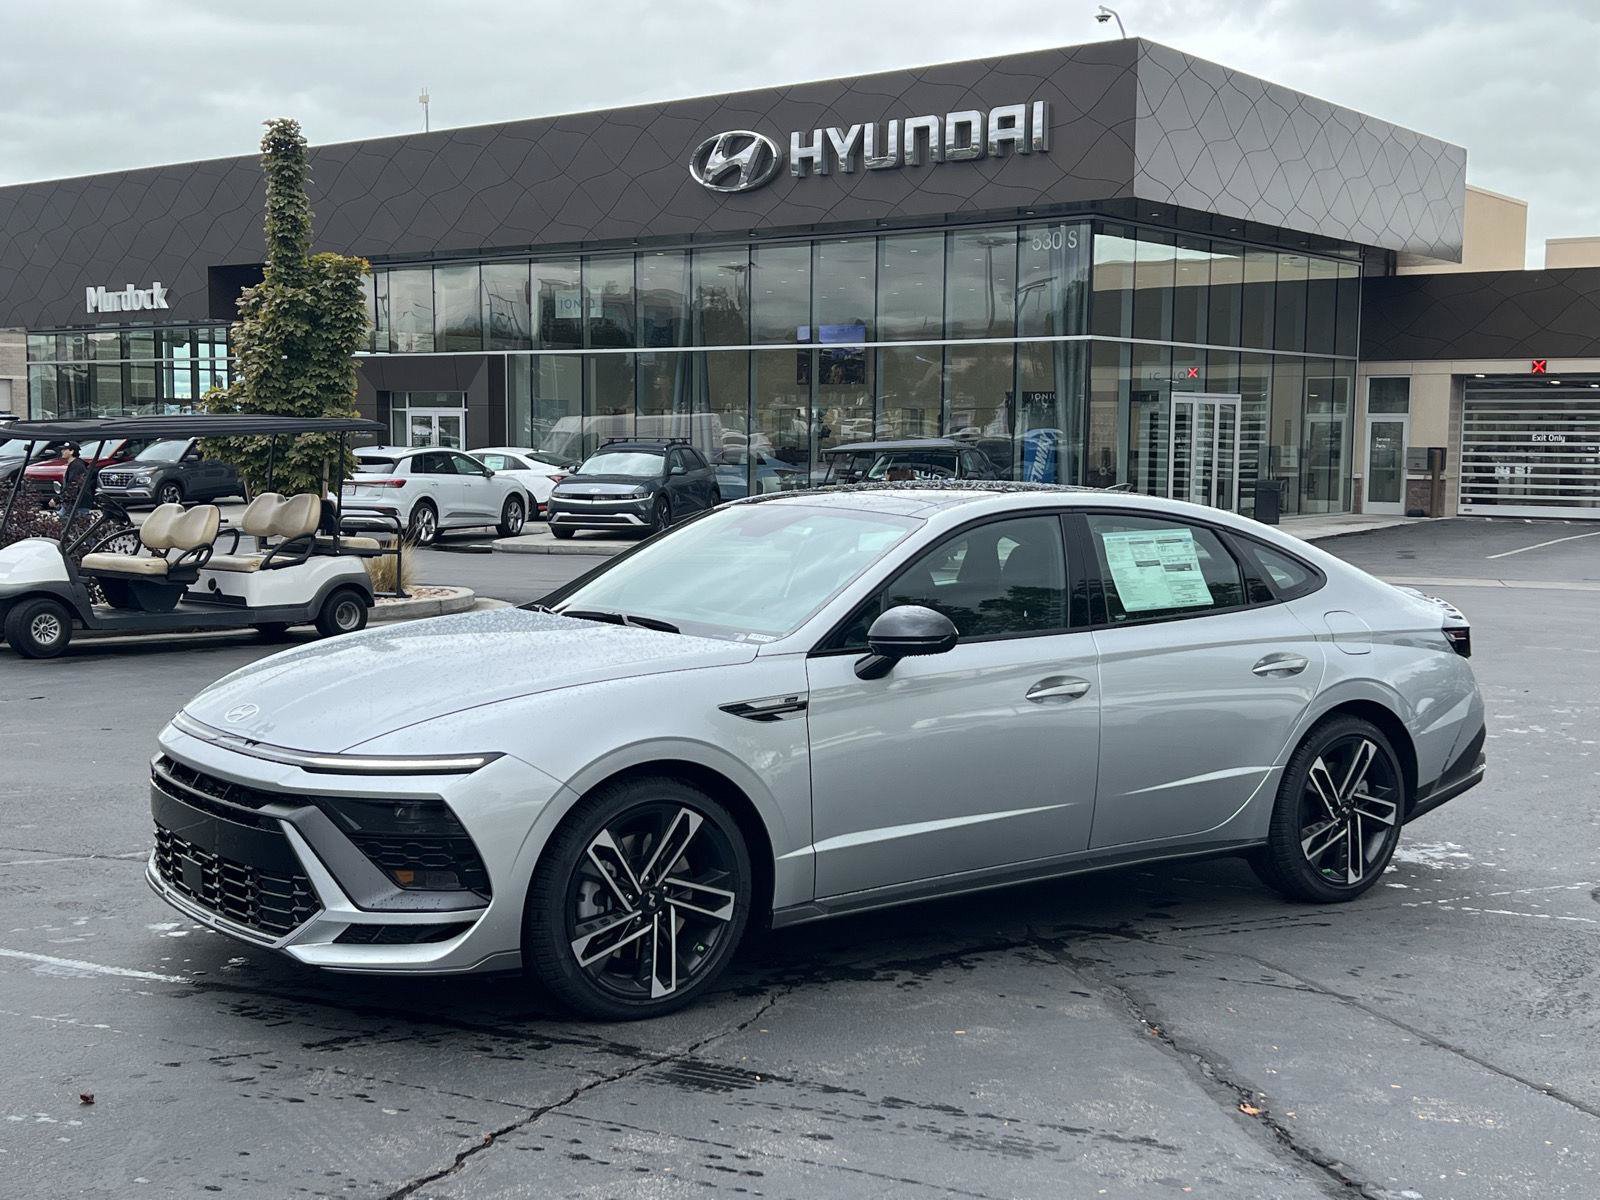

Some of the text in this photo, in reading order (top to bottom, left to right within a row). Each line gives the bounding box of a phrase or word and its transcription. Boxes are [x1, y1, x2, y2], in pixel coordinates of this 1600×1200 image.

[790, 101, 1049, 177] HYUNDAI
[1067, 230, 1078, 249] S
[86, 281, 169, 313] Murdock
[1531, 434, 1566, 445] Exit Only
